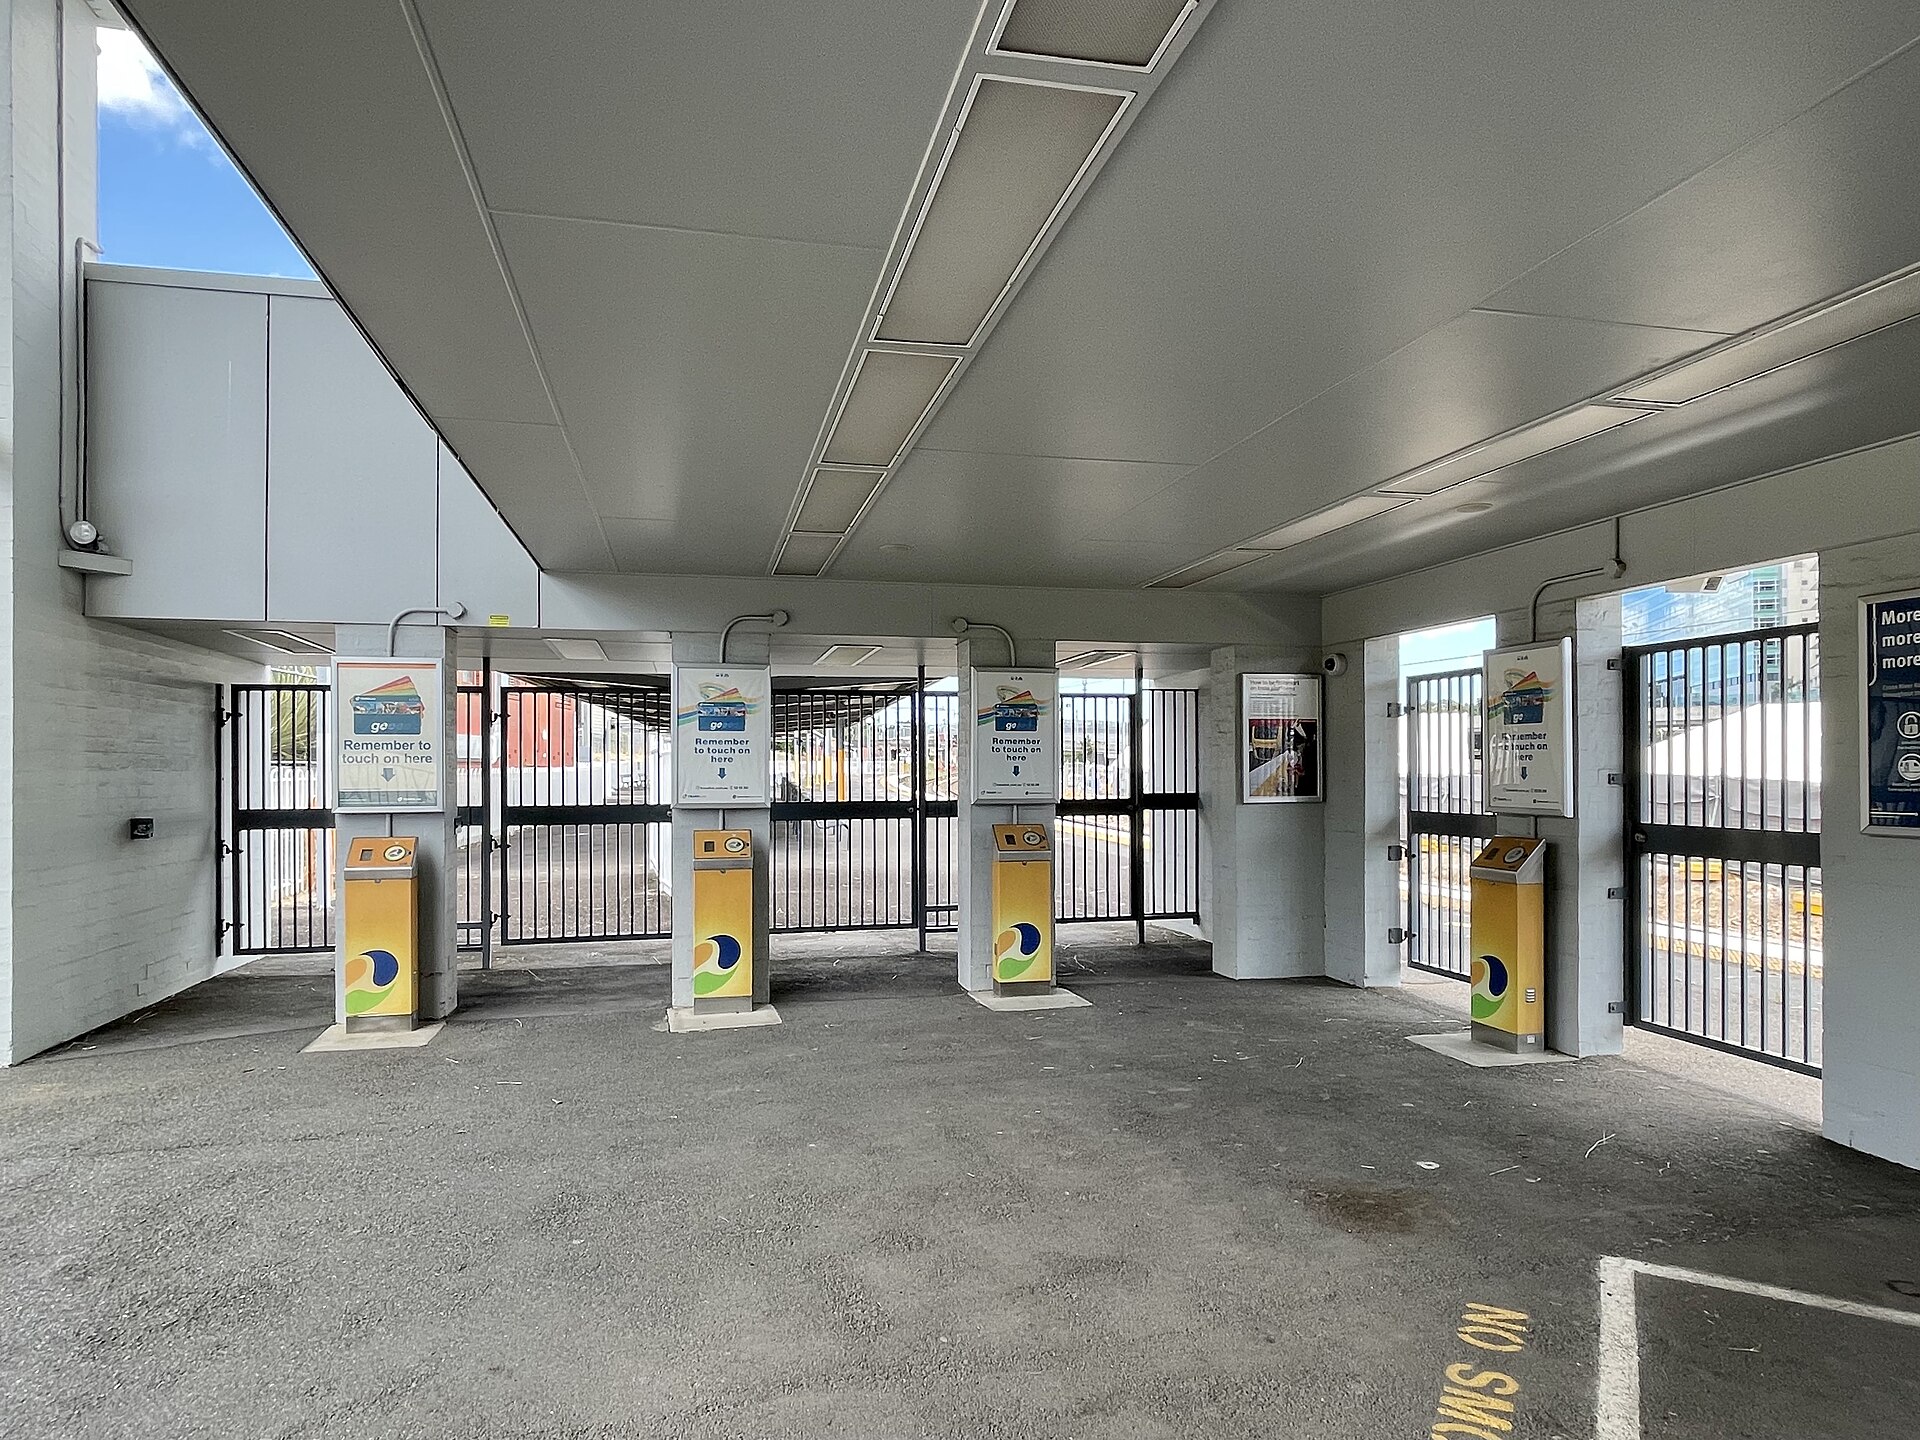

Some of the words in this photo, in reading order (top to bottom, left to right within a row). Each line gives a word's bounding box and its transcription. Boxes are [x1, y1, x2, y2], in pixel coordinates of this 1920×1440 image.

[370, 722, 388, 733] go
[710, 721, 722, 730] go
[1005, 722, 1017, 731] go
[344, 740, 415, 751] Remember
[418, 741, 431, 751] to
[1003, 745, 1028, 753] touch
[342, 754, 379, 764] touch
[383, 755, 400, 764] on
[404, 754, 433, 764] here
[711, 755, 733, 763] here
[1457, 1302, 1529, 1352] NO
